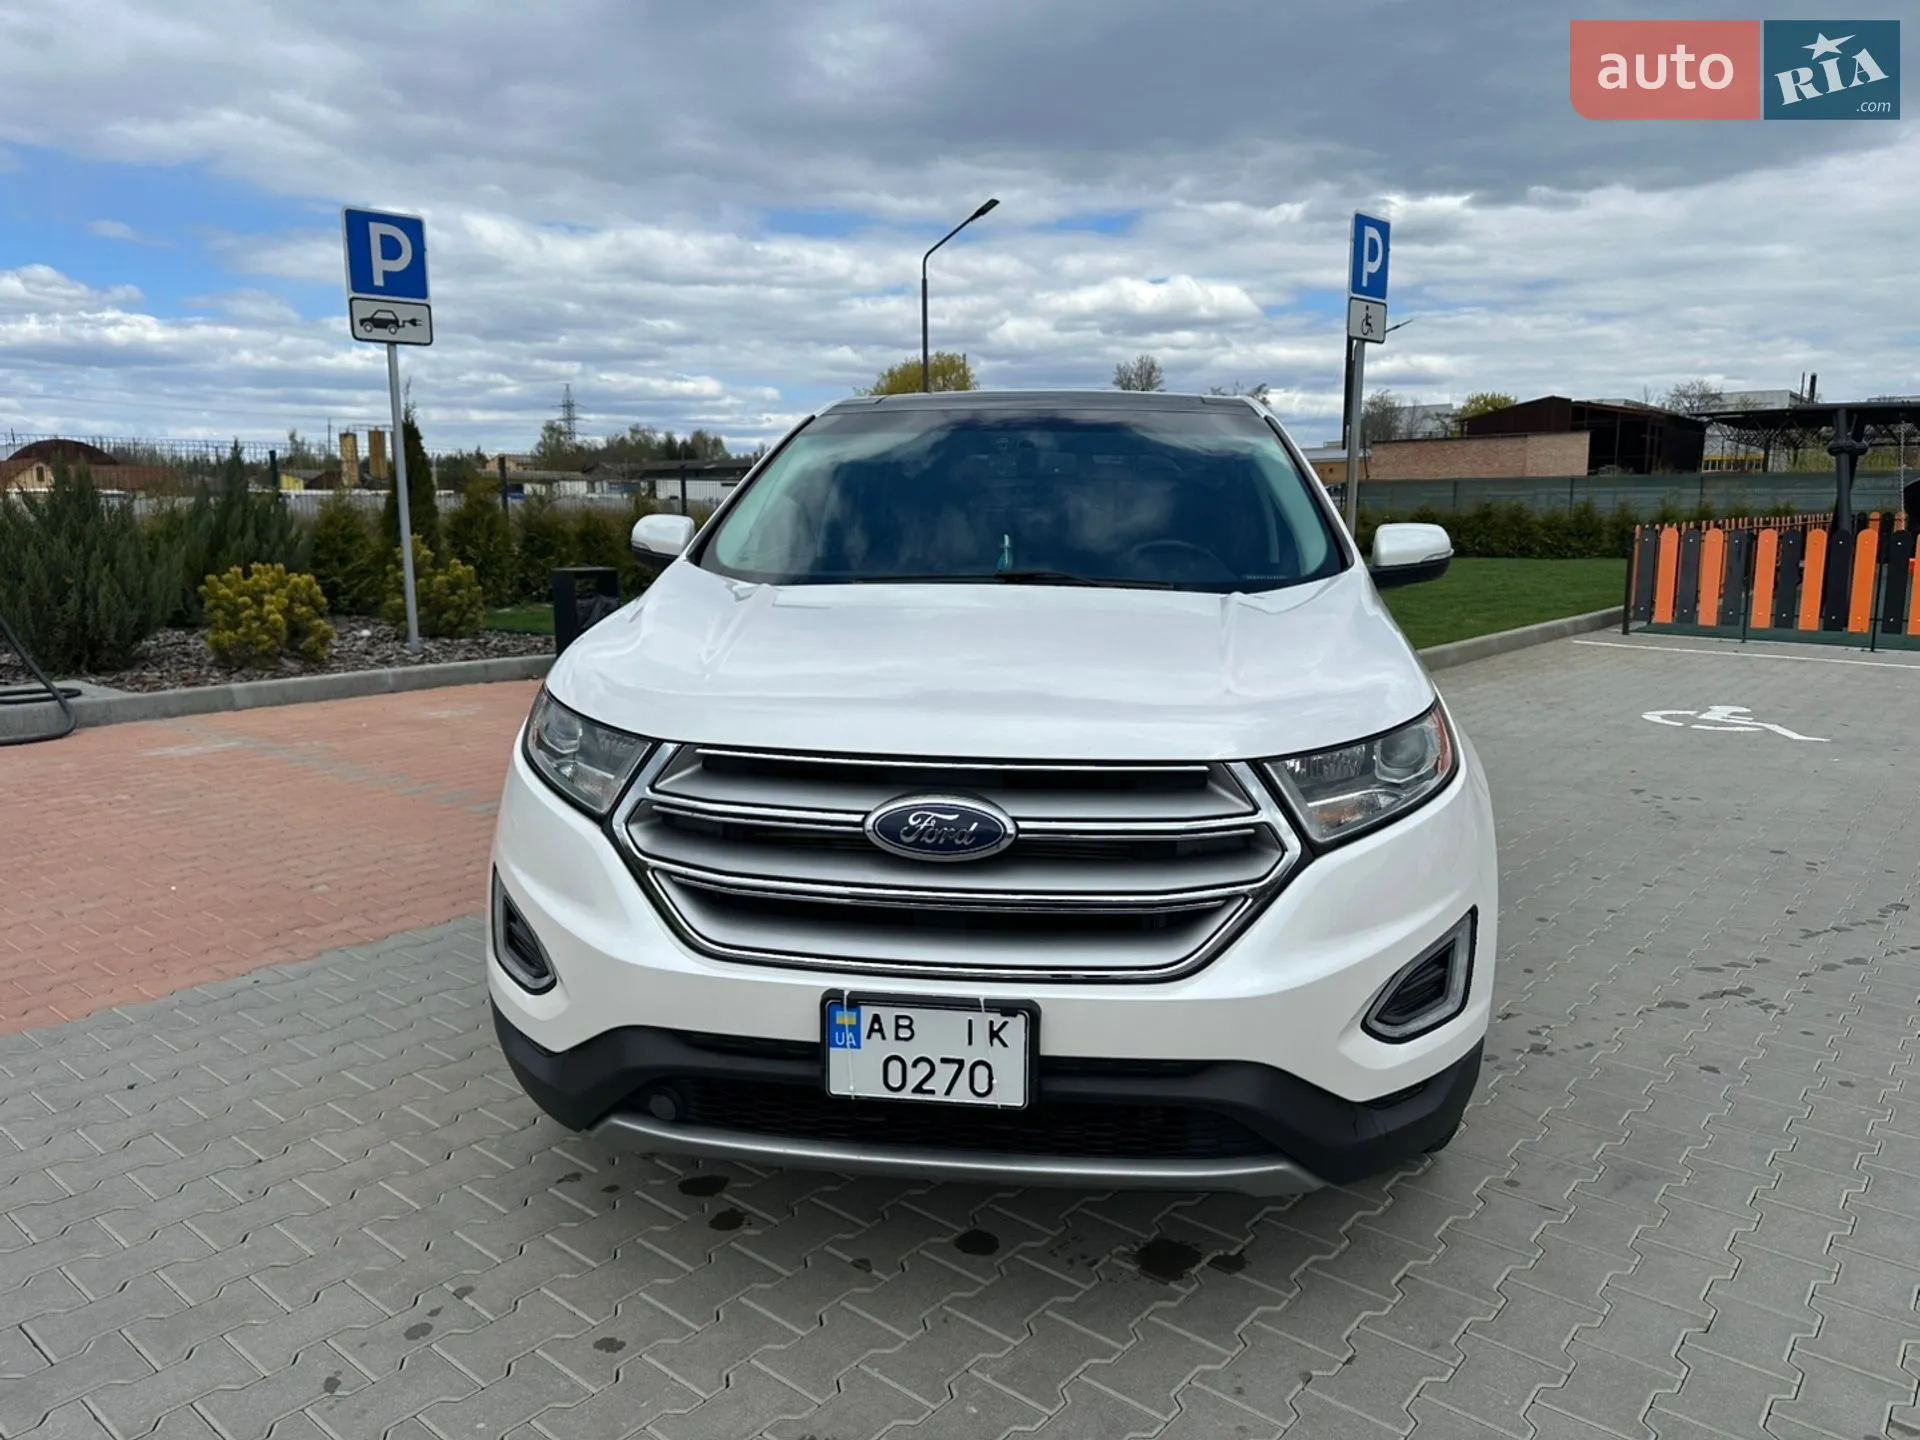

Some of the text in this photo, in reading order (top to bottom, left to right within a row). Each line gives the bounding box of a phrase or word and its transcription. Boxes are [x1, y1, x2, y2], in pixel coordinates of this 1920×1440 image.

[368, 221, 413, 287] P
[1361, 225, 1383, 288] P
[900, 810, 979, 846] Ford
[835, 1031, 857, 1047] UA
[866, 1013, 1010, 1049] AB IK
[882, 1054, 994, 1098] 0270
